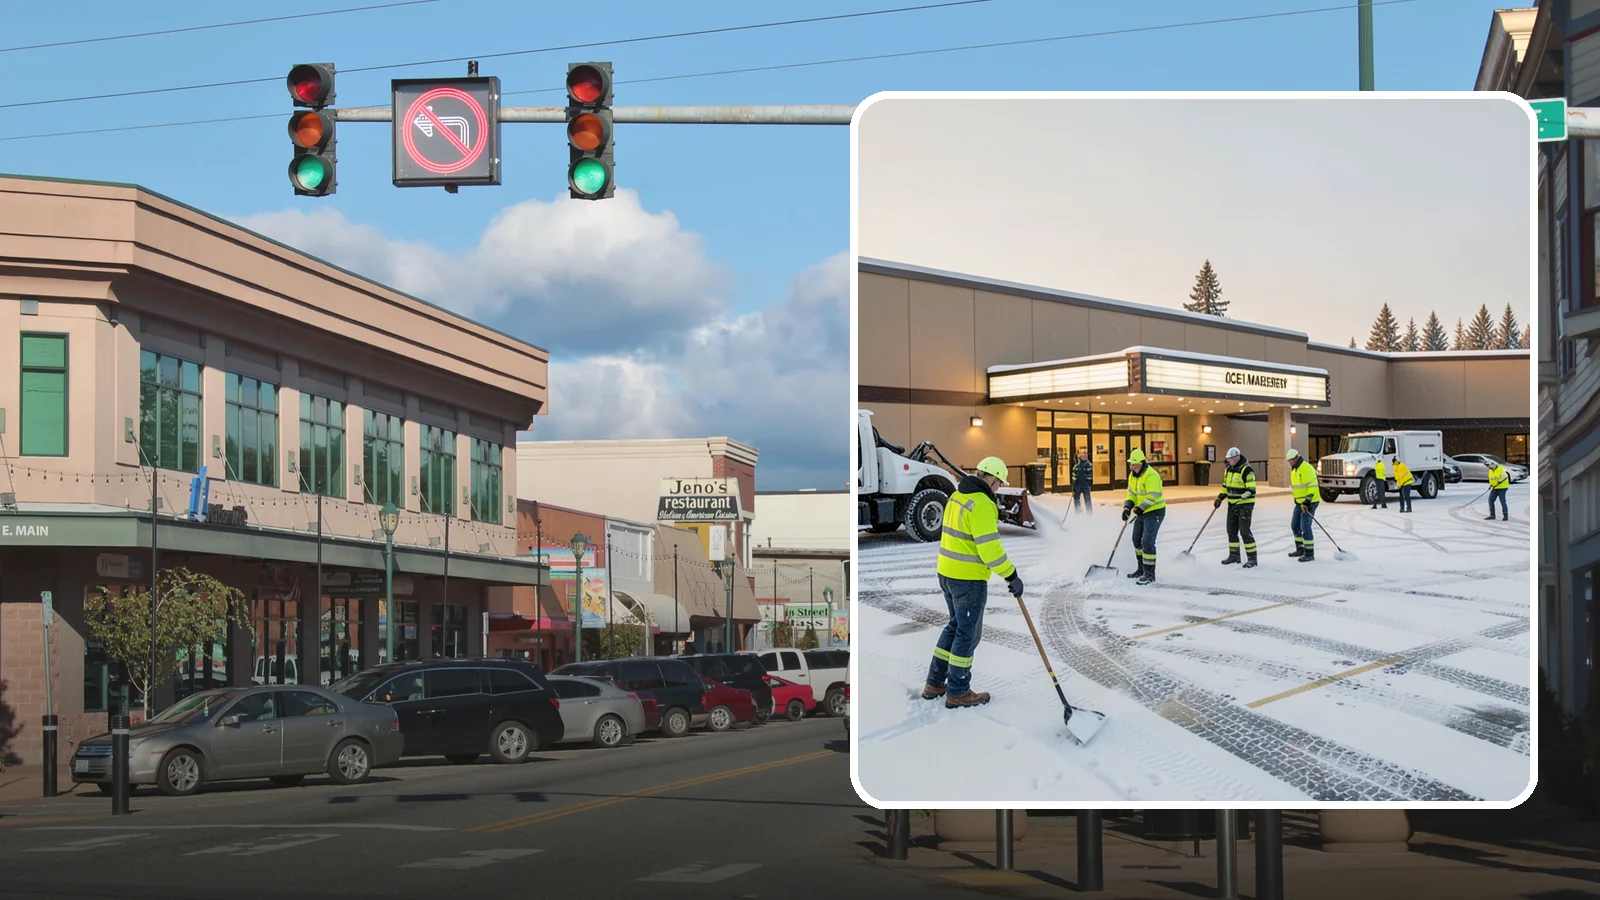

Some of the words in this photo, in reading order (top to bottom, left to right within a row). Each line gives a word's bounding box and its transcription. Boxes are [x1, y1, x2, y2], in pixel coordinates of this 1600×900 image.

[669, 480, 727, 495] Jeno's
[665, 496, 731, 509] restaurant
[686, 510, 714, 519] American
[715, 509, 737, 519] Cuisine
[2, 525, 13, 536] E.
[15, 525, 49, 536] MAIN
[797, 607, 829, 617] Street
